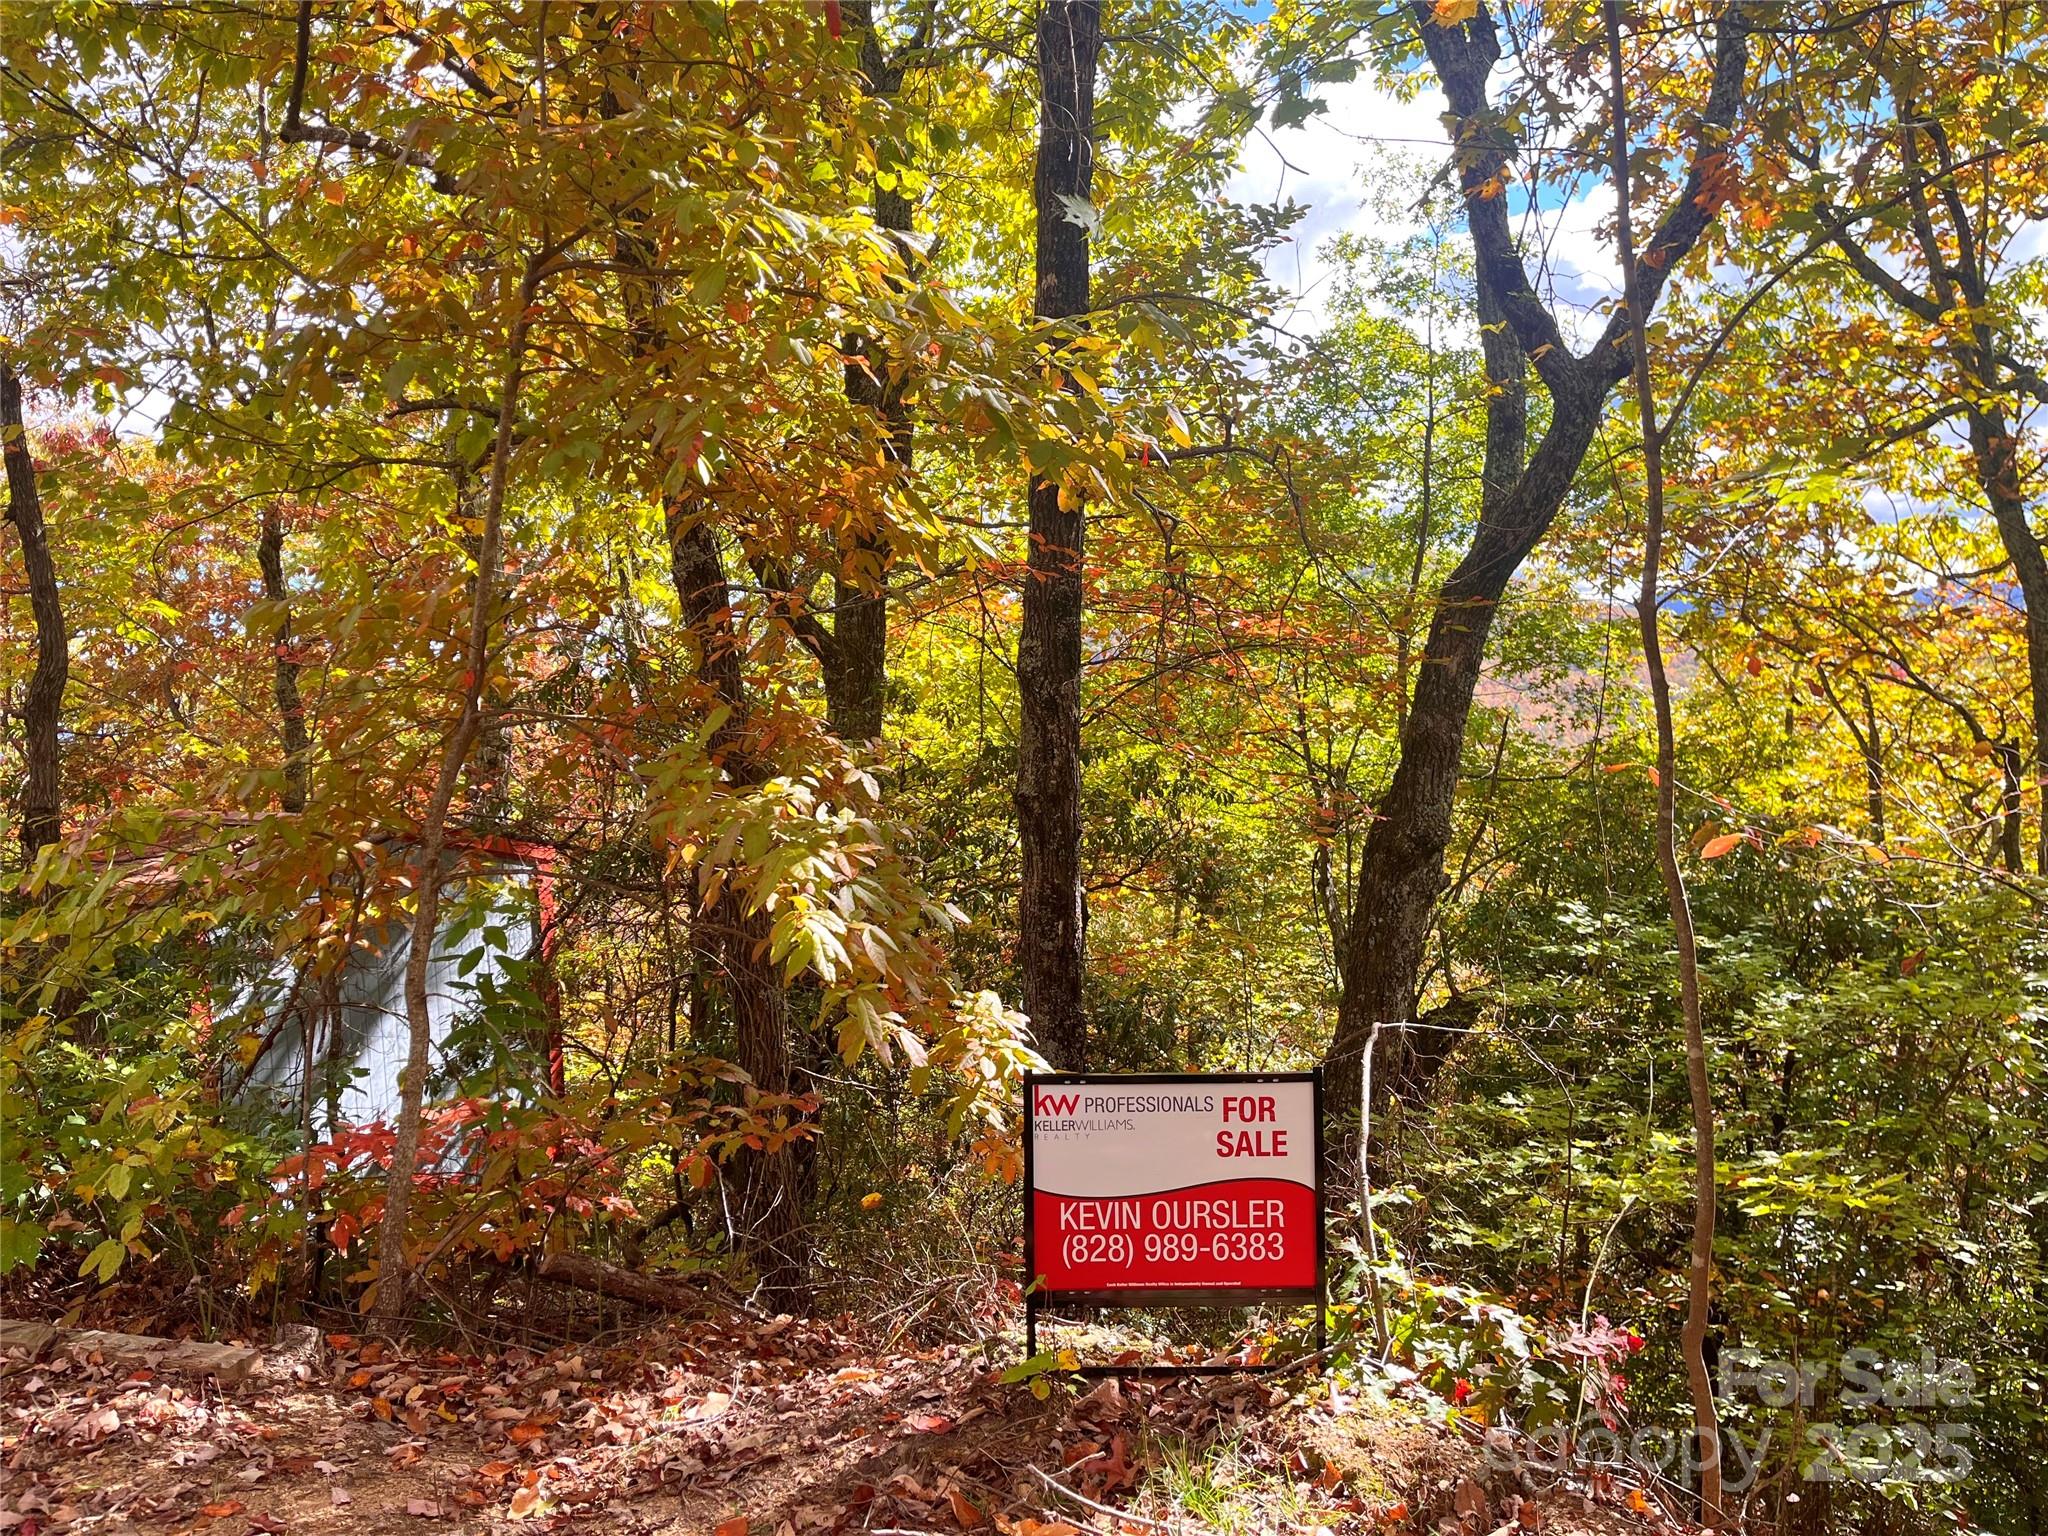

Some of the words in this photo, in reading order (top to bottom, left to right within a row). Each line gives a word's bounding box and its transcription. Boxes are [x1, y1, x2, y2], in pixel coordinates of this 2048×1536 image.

[1084, 1096, 1214, 1114] PROFESSIONALS
[1222, 1096, 1276, 1123] FOR
[1034, 1132, 1091, 1142] REALTY
[1216, 1130, 1288, 1158] SALE
[1060, 1201, 1141, 1231] KEVIN
[1152, 1199, 1285, 1230] OURSLER
[1062, 1233, 1134, 1270] (828)
[1143, 1231, 1285, 1263] 989-6383
